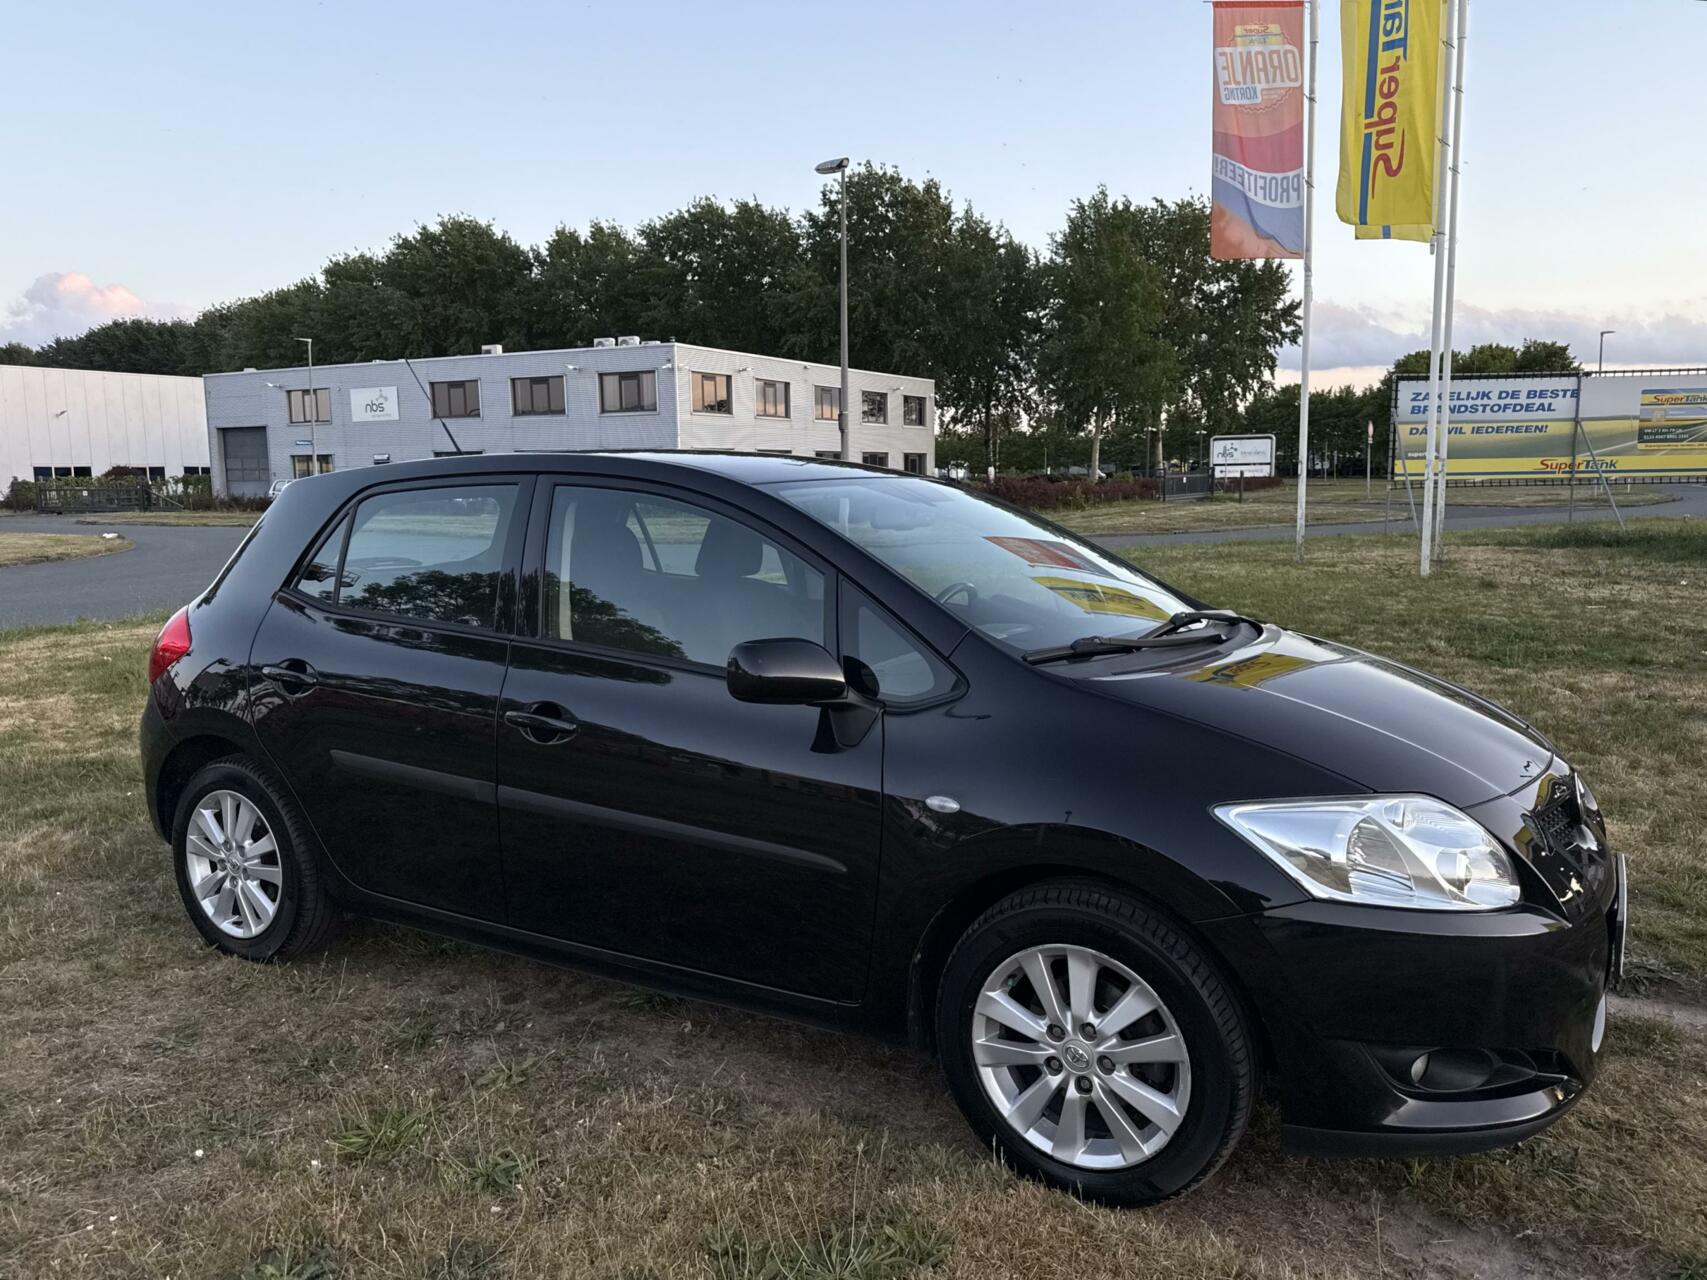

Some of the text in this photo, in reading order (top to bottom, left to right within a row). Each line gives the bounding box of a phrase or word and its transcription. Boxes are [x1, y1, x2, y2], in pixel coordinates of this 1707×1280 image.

[1498, 390, 1521, 400] DE
[1526, 388, 1581, 399] BESTE
[365, 400, 385, 413] nbs
[1471, 424, 1548, 434] IEDEREEN!
